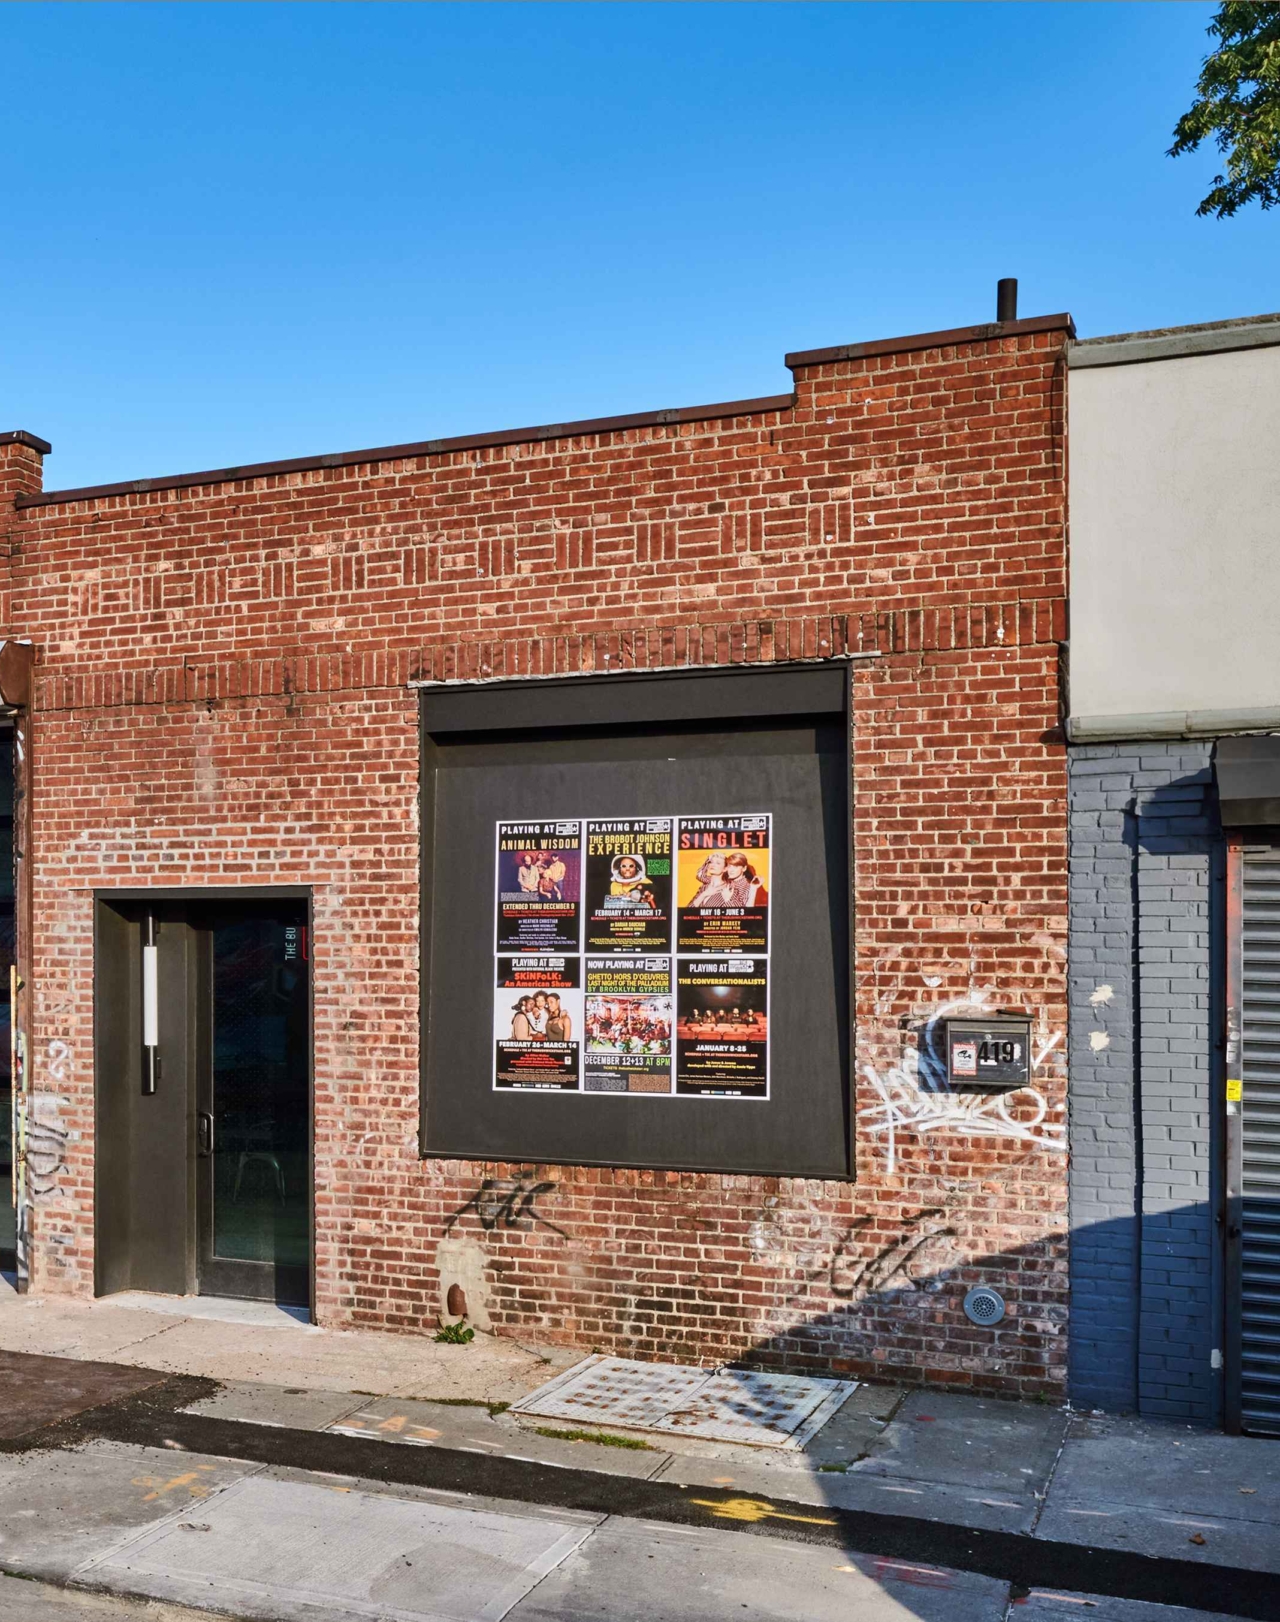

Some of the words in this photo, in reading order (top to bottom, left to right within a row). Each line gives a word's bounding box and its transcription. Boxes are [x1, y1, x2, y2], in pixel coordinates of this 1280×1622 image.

[589, 823, 630, 832] PLAYING
[634, 823, 645, 831] AT
[681, 820, 723, 829] PLAYING
[728, 820, 739, 828] AT
[501, 825, 540, 834] PLAYING
[544, 825, 554, 833] AT
[589, 835, 603, 844] THE
[605, 835, 634, 843] BROBOT
[636, 834, 670, 843] JOHNSON
[681, 832, 766, 848] SINGLET
[501, 840, 536, 850] ANIMAL
[541, 838, 579, 849] WISDOM
[589, 843, 670, 855] EXPERIENCE
[284, 942, 296, 960] THE
[512, 959, 538, 967] PLAYING
[588, 961, 604, 969] NOW
[689, 964, 717, 972] PLAYING
[719, 964, 727, 972] AT
[514, 972, 562, 980] SKiNFoLK:
[977, 1042, 1014, 1063] 419
[585, 1056, 619, 1065] DECEMBER
[622, 1057, 643, 1065] 12+13
[646, 1057, 654, 1066] AT
[656, 1058, 670, 1066] 8PM
